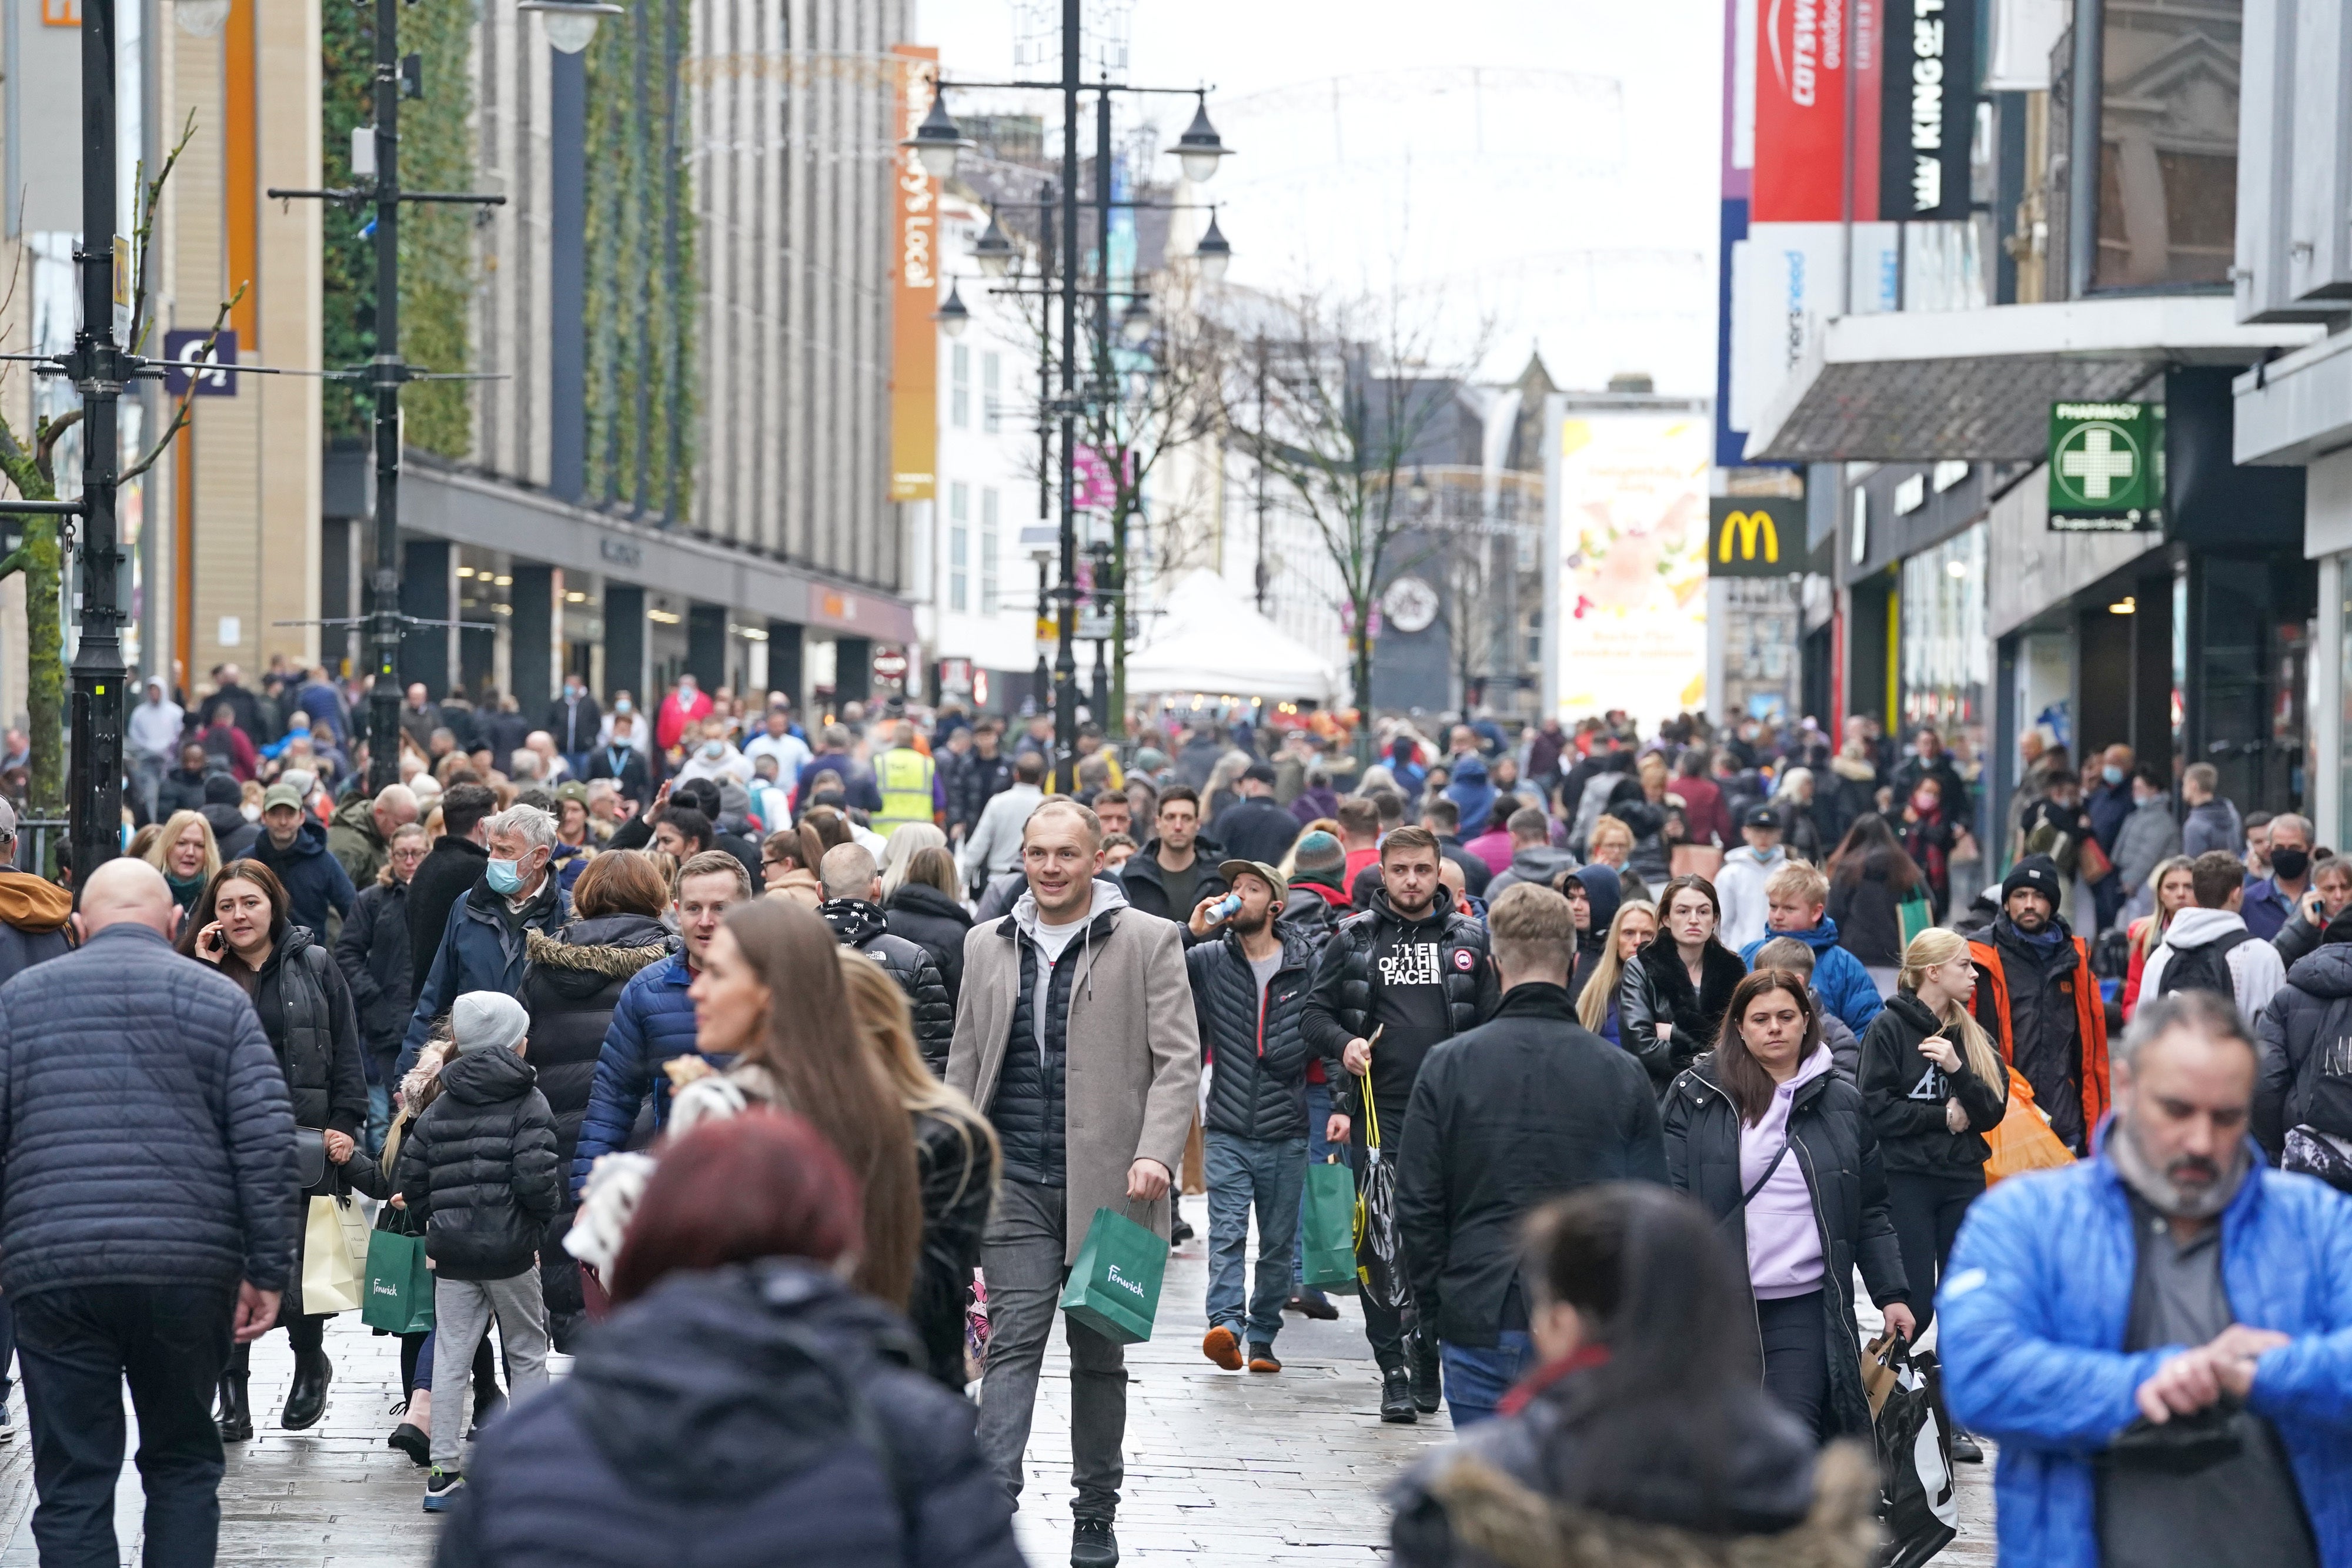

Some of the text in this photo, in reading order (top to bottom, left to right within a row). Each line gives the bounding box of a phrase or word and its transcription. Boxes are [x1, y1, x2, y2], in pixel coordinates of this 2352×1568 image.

[1913, 18, 1936, 57] OF
[1792, 0, 1817, 107] COTSW
[1912, 58, 1943, 149] KING
[904, 216, 935, 288] Local
[2056, 403, 2141, 420] PHARMACY
[1392, 943, 1429, 957] THE
[1379, 955, 1430, 972] ORTH
[1384, 969, 1430, 985] FACE
[373, 1278, 397, 1296] Fenwick
[1108, 1265, 1144, 1298] Fenwick
